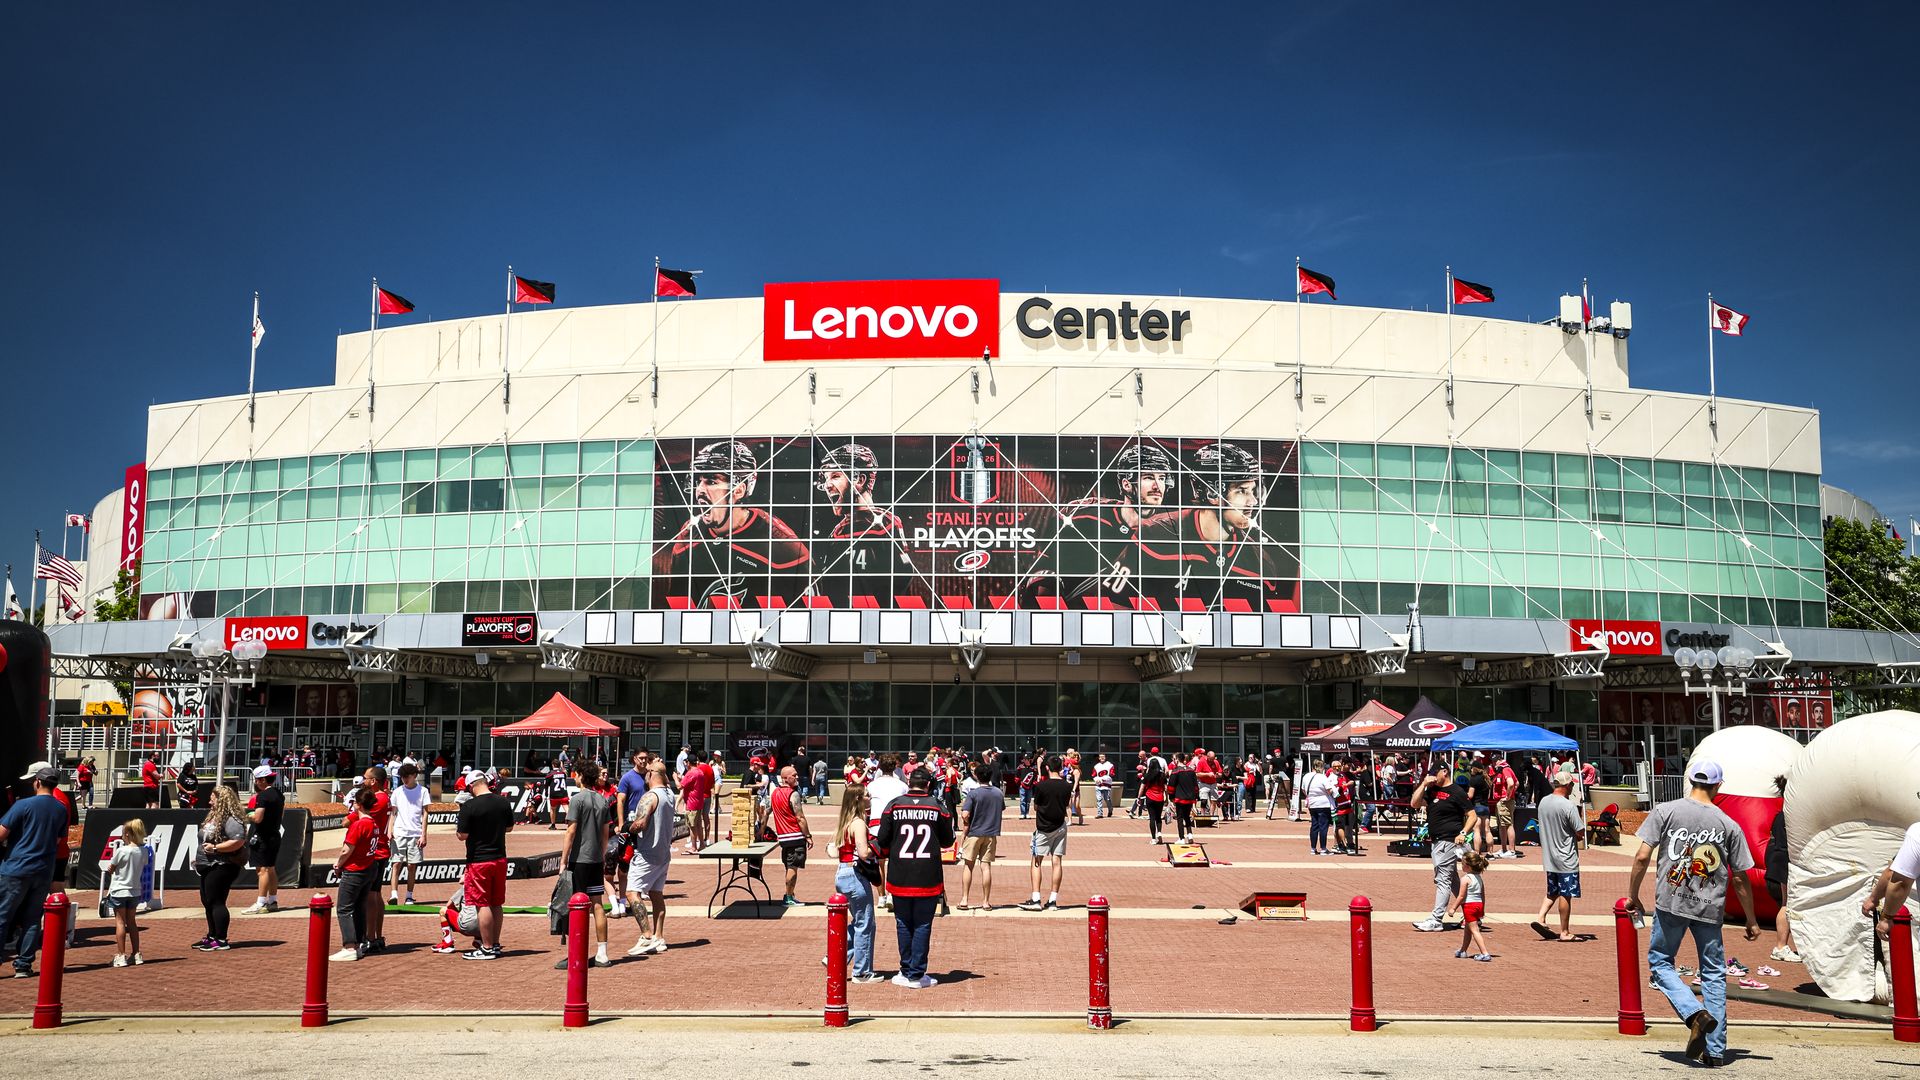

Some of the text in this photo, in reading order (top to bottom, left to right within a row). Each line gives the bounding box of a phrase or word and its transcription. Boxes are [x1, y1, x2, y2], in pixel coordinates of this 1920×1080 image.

[784, 296, 1191, 341] Lenovo Center
[926, 512, 1024, 525] STANLEY CUP
[127, 479, 139, 597] novo
[914, 527, 1037, 549] PLAYOFFS
[1102, 561, 1131, 594] 20
[231, 624, 299, 642] Lenovo
[466, 623, 514, 633] PLAYOFFS
[1665, 628, 1729, 648] Center
[738, 739, 777, 747] SIREN
[1385, 738, 1431, 747] CAROLINA
[554, 778, 567, 791] 24
[427, 813, 459, 823] OLINA
[892, 809, 939, 821] STANKOVEN
[899, 823, 931, 859] 22
[1667, 827, 1724, 861] Coors
[415, 862, 516, 880] HURRIS
